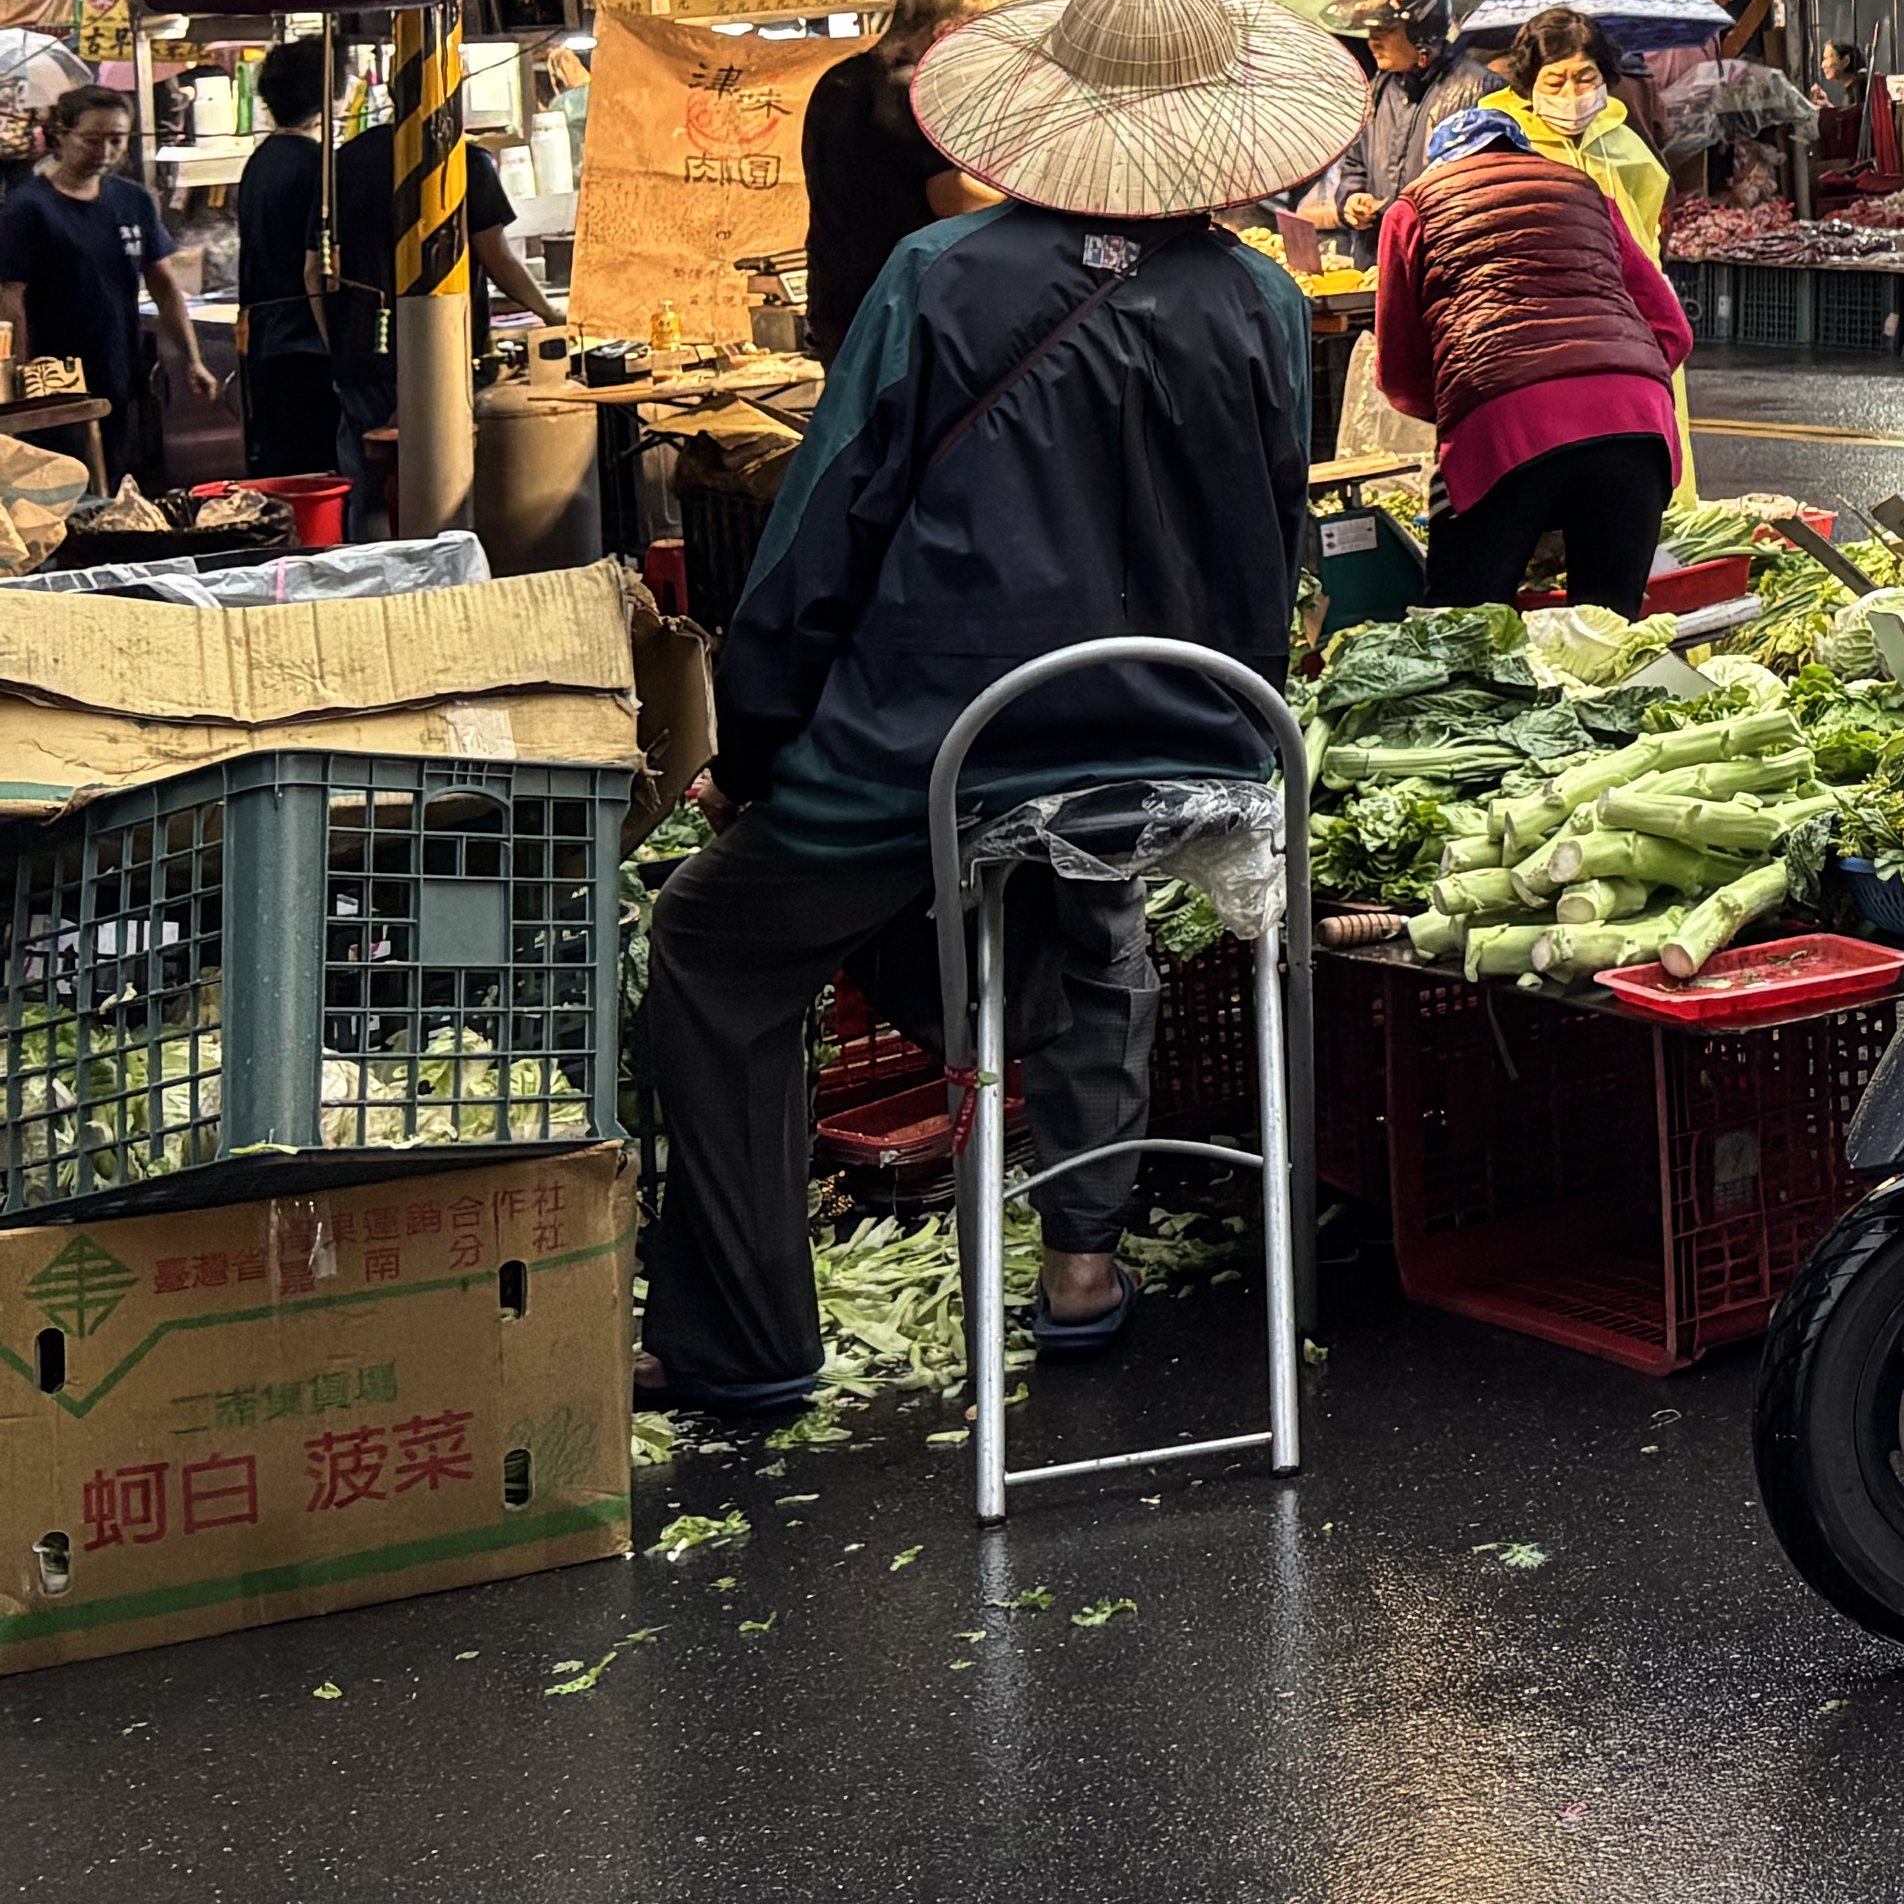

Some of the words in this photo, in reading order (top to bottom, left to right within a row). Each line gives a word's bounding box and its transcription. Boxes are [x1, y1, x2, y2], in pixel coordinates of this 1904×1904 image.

[684, 152, 781, 191] 肉圓
[83, 1451, 259, 1552] 蚵白
[303, 1409, 474, 1514] 菠菜
